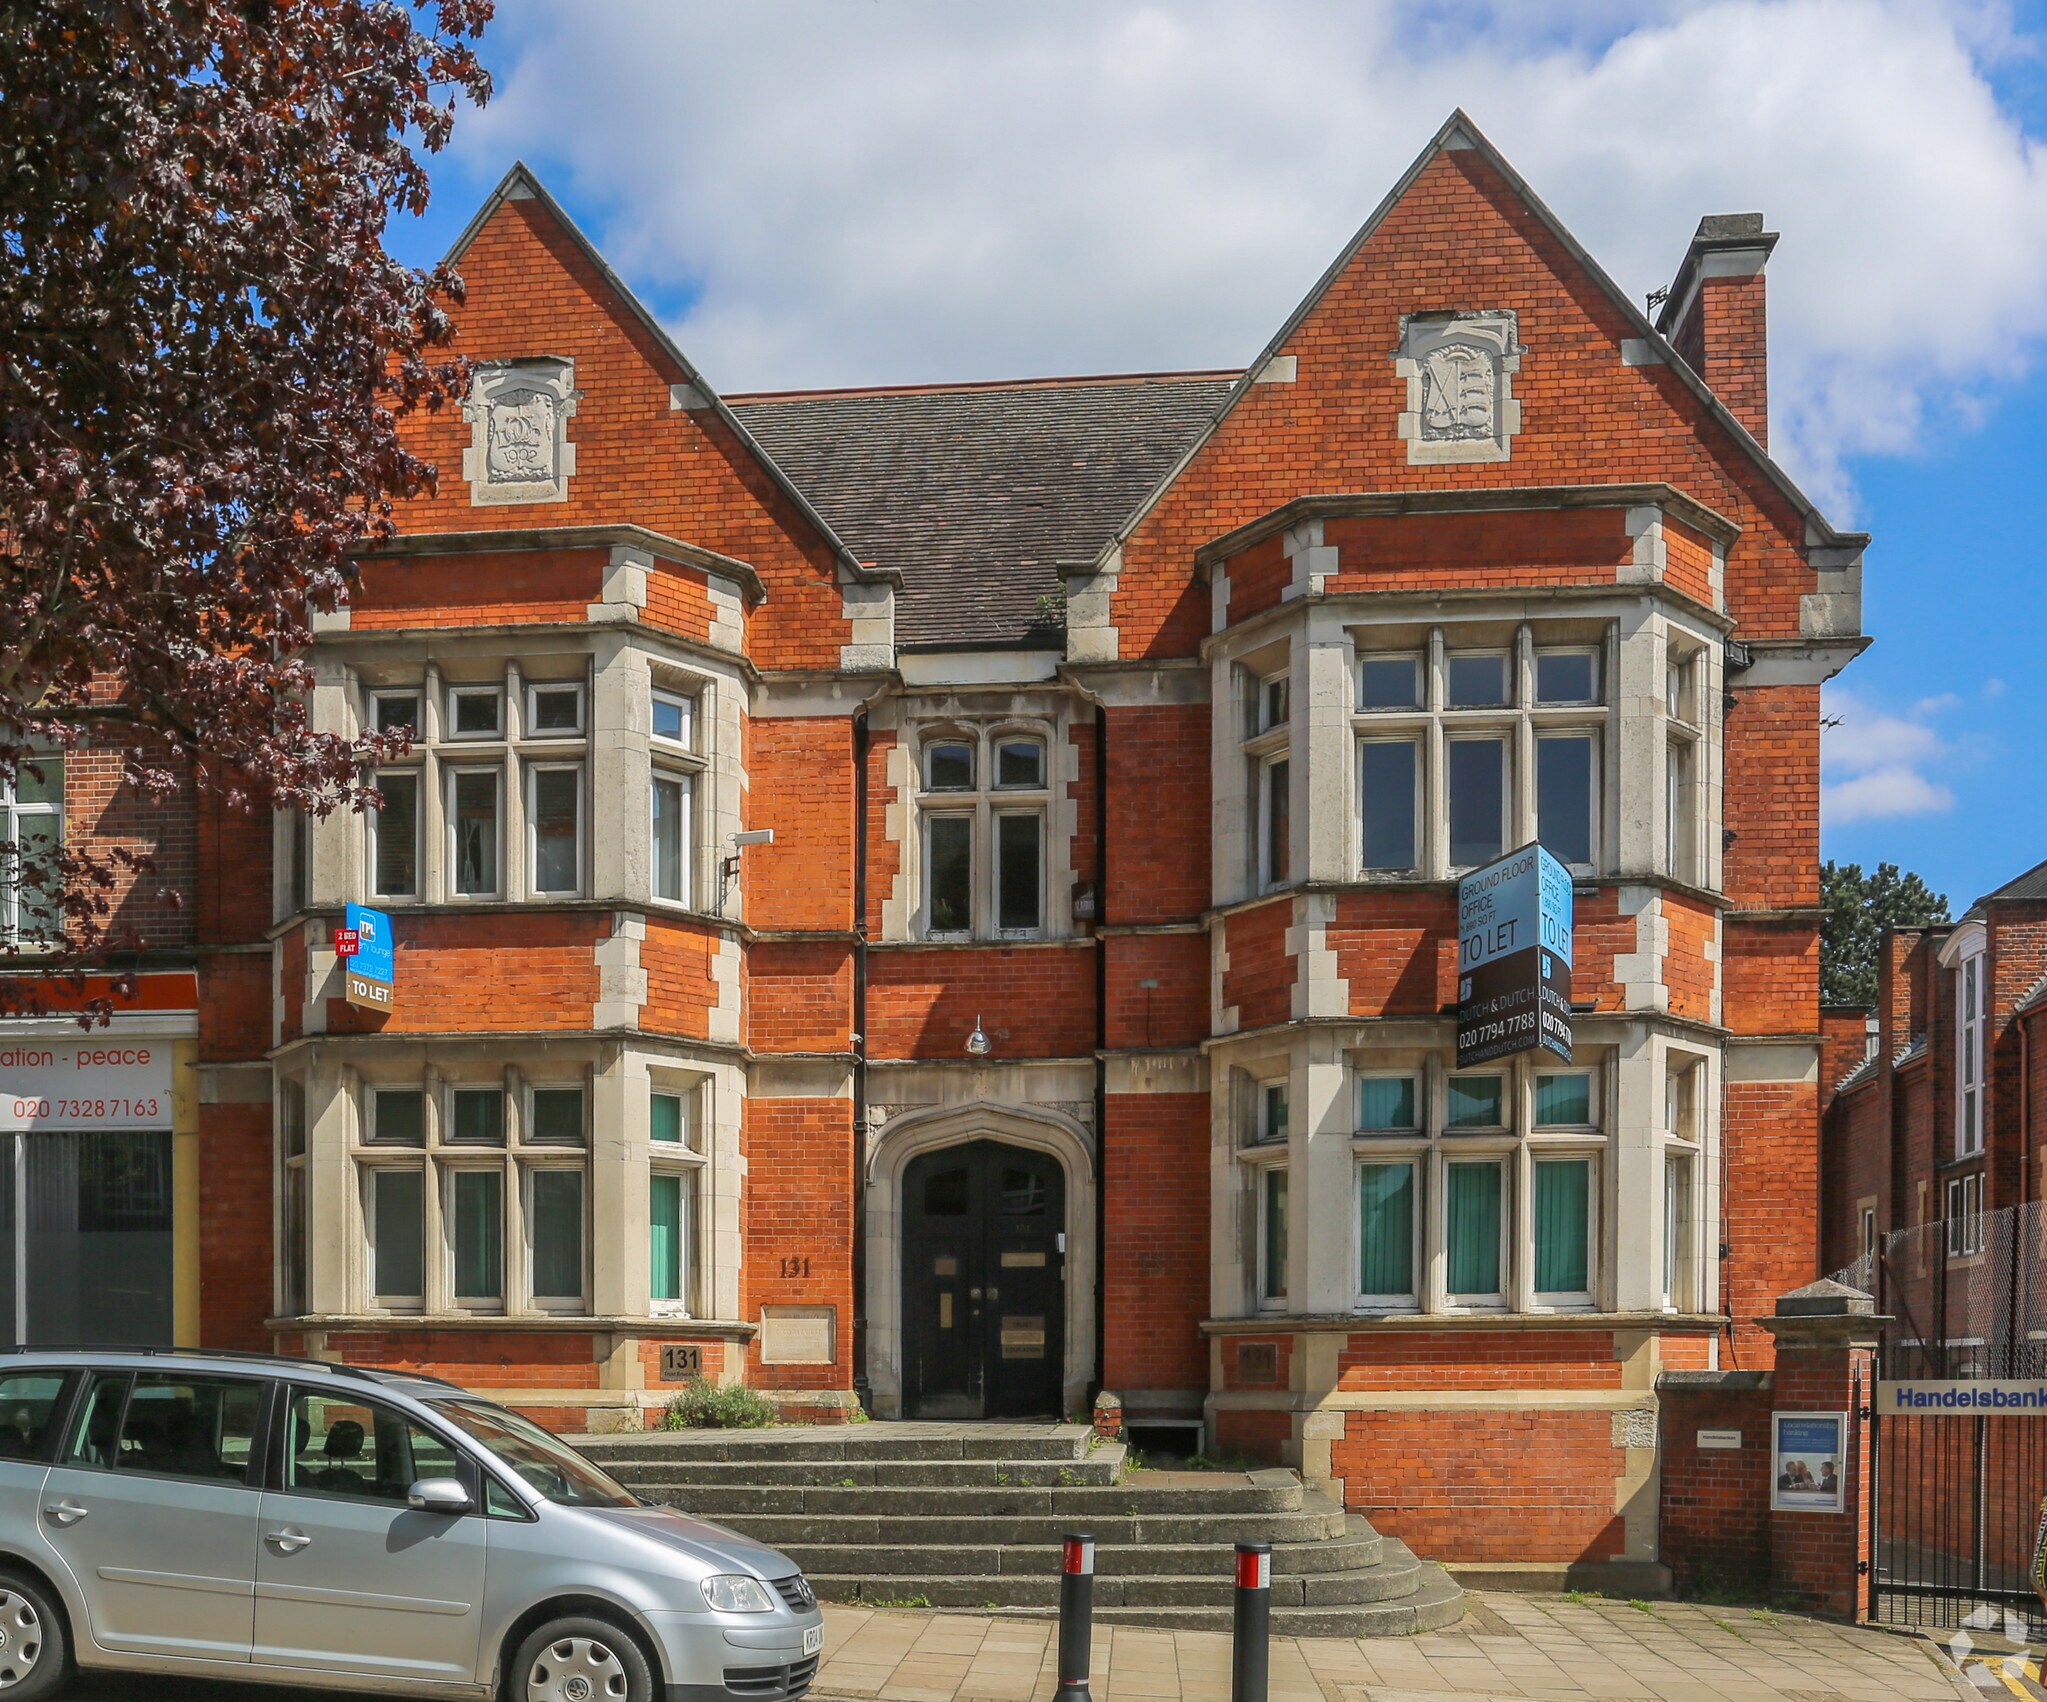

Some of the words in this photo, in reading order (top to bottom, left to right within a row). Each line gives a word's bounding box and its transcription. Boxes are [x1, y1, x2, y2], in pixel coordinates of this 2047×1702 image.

[503, 448, 538, 464] 1902
[1461, 872, 1500, 901] GROUND
[1501, 856, 1534, 882] FLOOR
[1461, 893, 1493, 920] OFFICE
[360, 920, 376, 936] TPL
[1477, 914, 1488, 927] SQ
[1488, 910, 1497, 922] FT
[338, 931, 343, 940] 2
[343, 931, 357, 940] BED
[1461, 932, 1483, 965] TO
[1487, 918, 1518, 955] LET
[1541, 911, 1556, 945] TO
[1557, 922, 1569, 957] LET
[339, 944, 356, 952] FLAT
[371, 943, 391, 959] lounge
[352, 980, 367, 997] TO
[369, 984, 389, 1003] LET
[1459, 1002, 1490, 1023] DUTCH
[1490, 998, 1499, 1013] &
[1500, 986, 1536, 1010] DUTCH
[1459, 1029, 1477, 1049] 020
[1479, 1020, 1505, 1043] 7794
[1507, 1011, 1535, 1035] 7788
[0, 1047, 53, 1067] ation
[77, 1049, 151, 1070] peace
[13, 1100, 50, 1118] 020
[779, 1256, 810, 1278] 131
[666, 1349, 697, 1369] 131
[1896, 1387, 2047, 1408] Handelsbank
